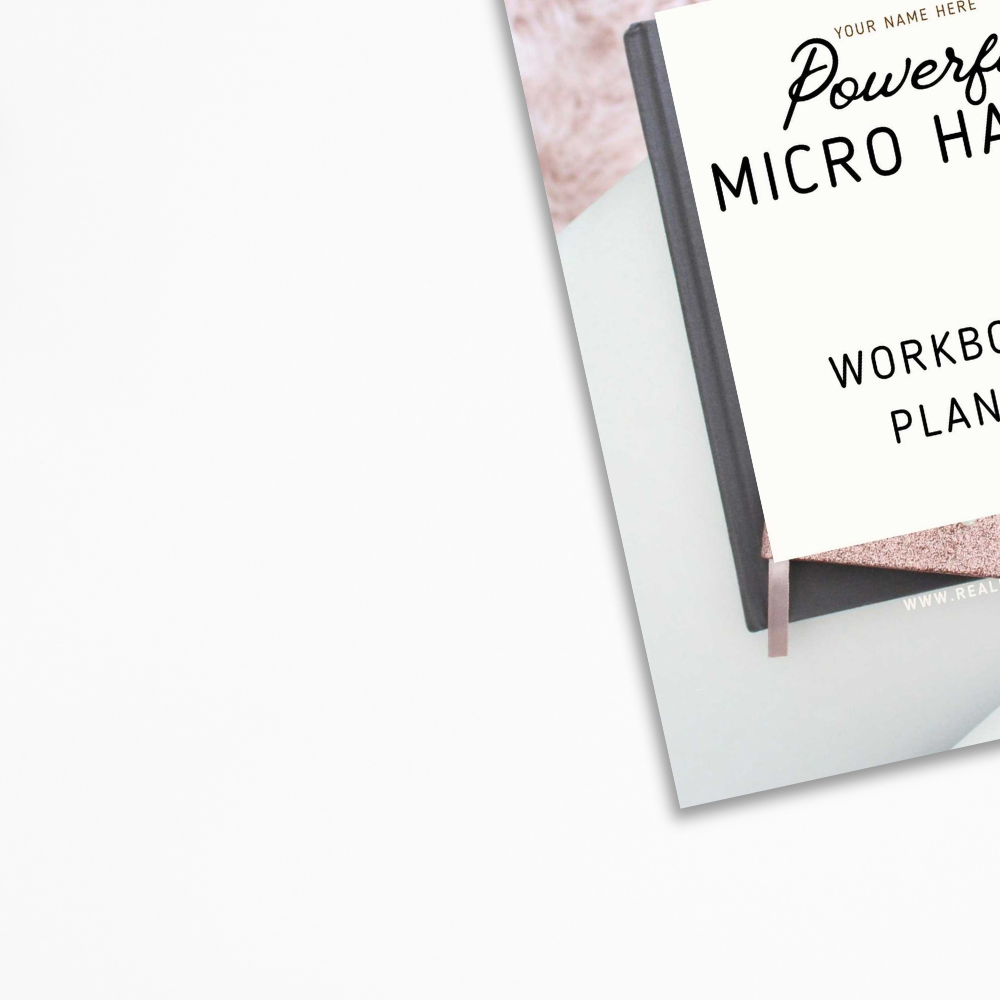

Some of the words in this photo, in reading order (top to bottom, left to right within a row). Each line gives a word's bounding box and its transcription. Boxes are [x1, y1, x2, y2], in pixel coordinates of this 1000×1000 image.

[833, 19, 877, 40] YOUR
[883, 7, 929, 29] NAME
[710, 126, 903, 213] MICRO
